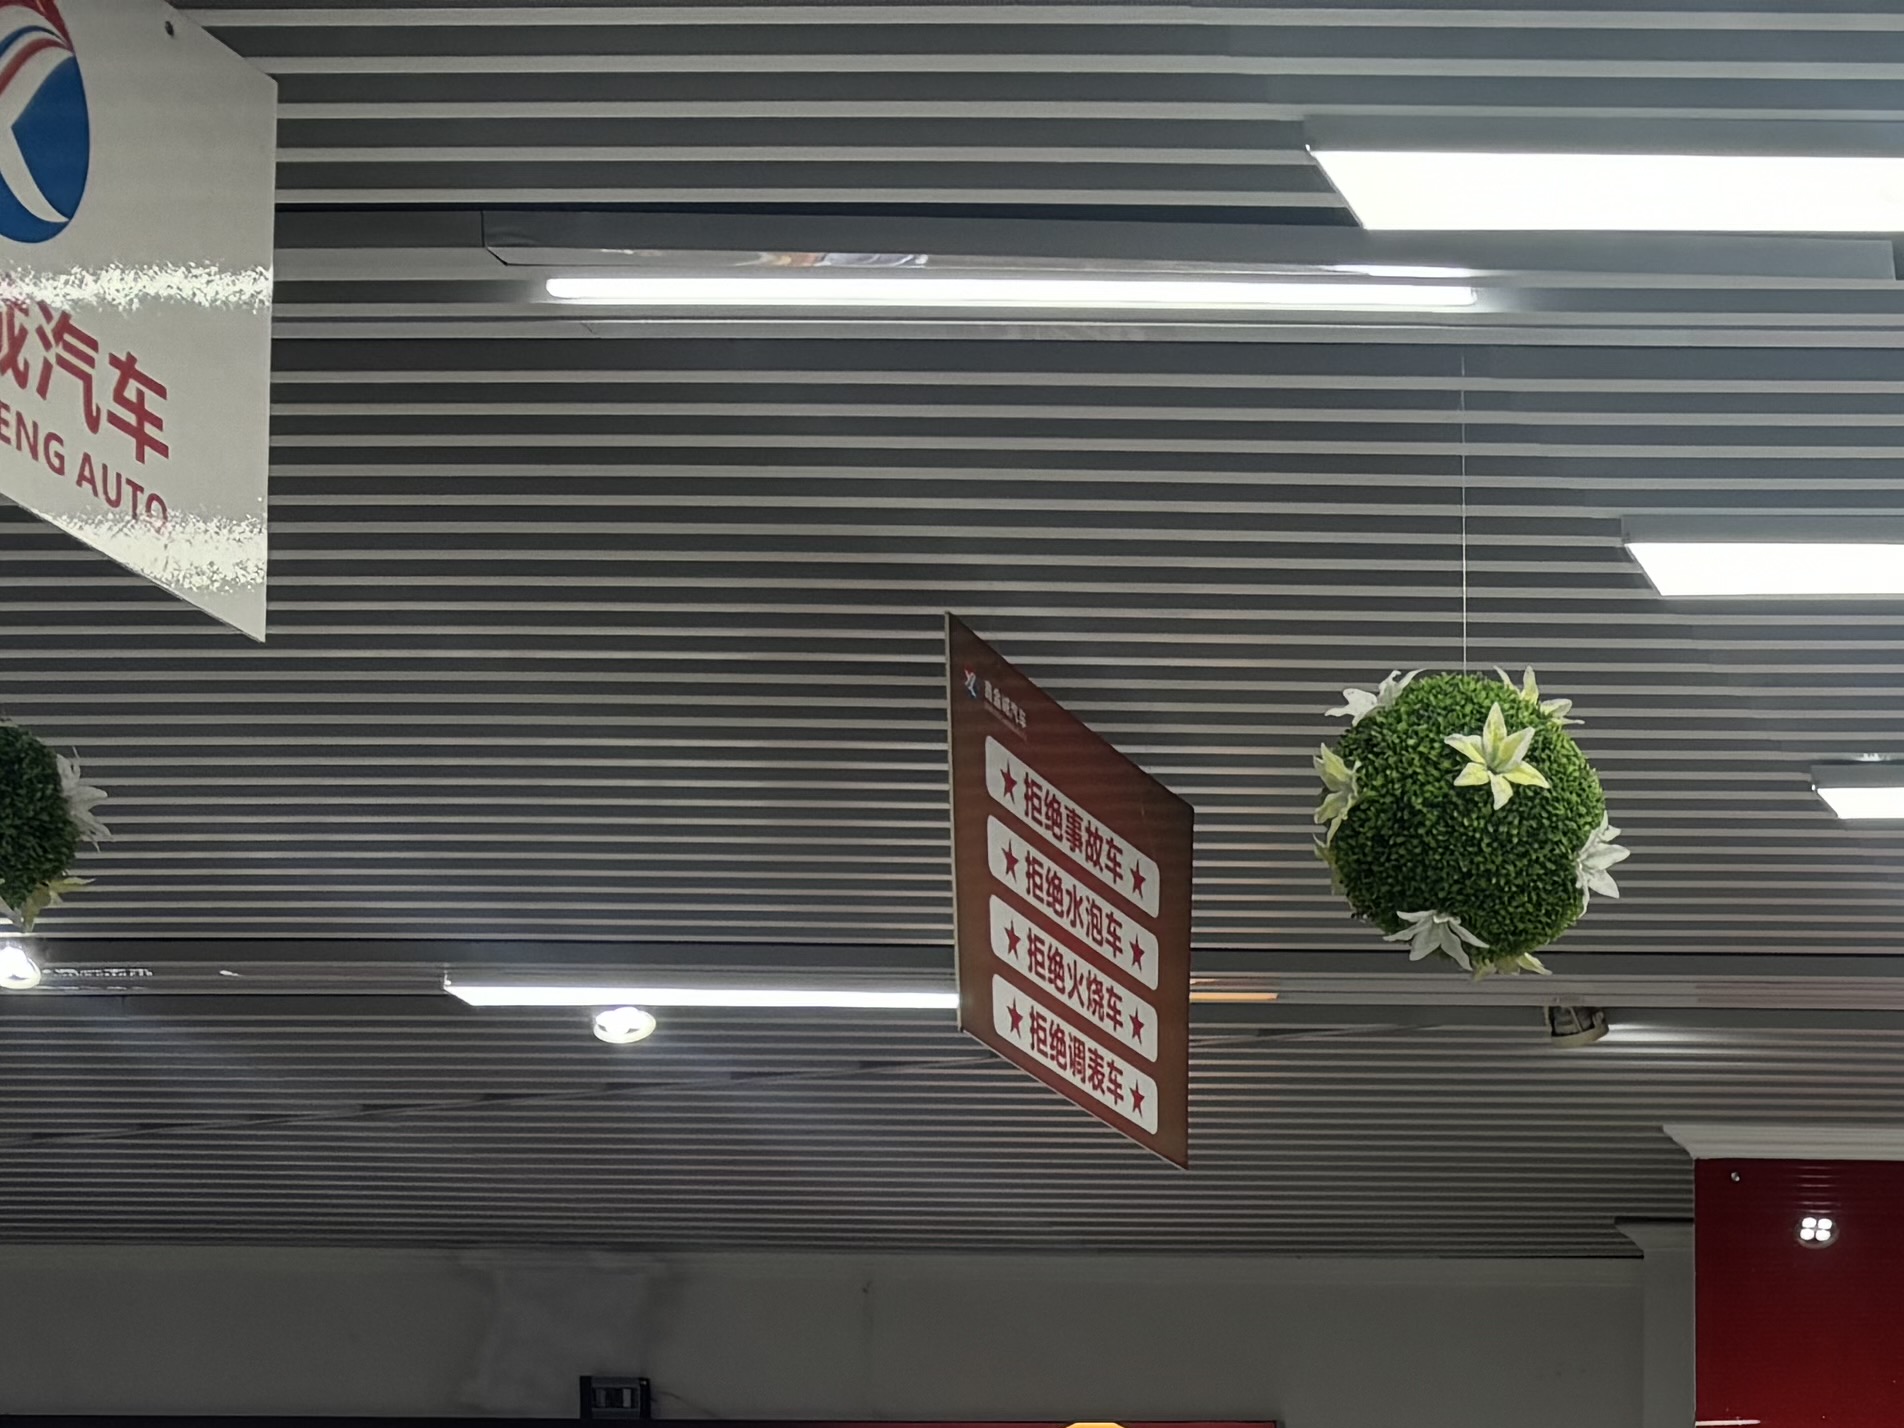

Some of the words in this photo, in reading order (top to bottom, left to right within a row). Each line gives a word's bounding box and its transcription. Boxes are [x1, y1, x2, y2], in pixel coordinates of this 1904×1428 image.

[76, 451, 168, 535] AUTO
[1023, 771, 1124, 885] 拒绝事故车
[1025, 849, 1124, 959] 拒绝水泡车
[1027, 926, 1124, 1033] 拒绝火烧车
[1029, 1004, 1125, 1106] 拒绝调表车
